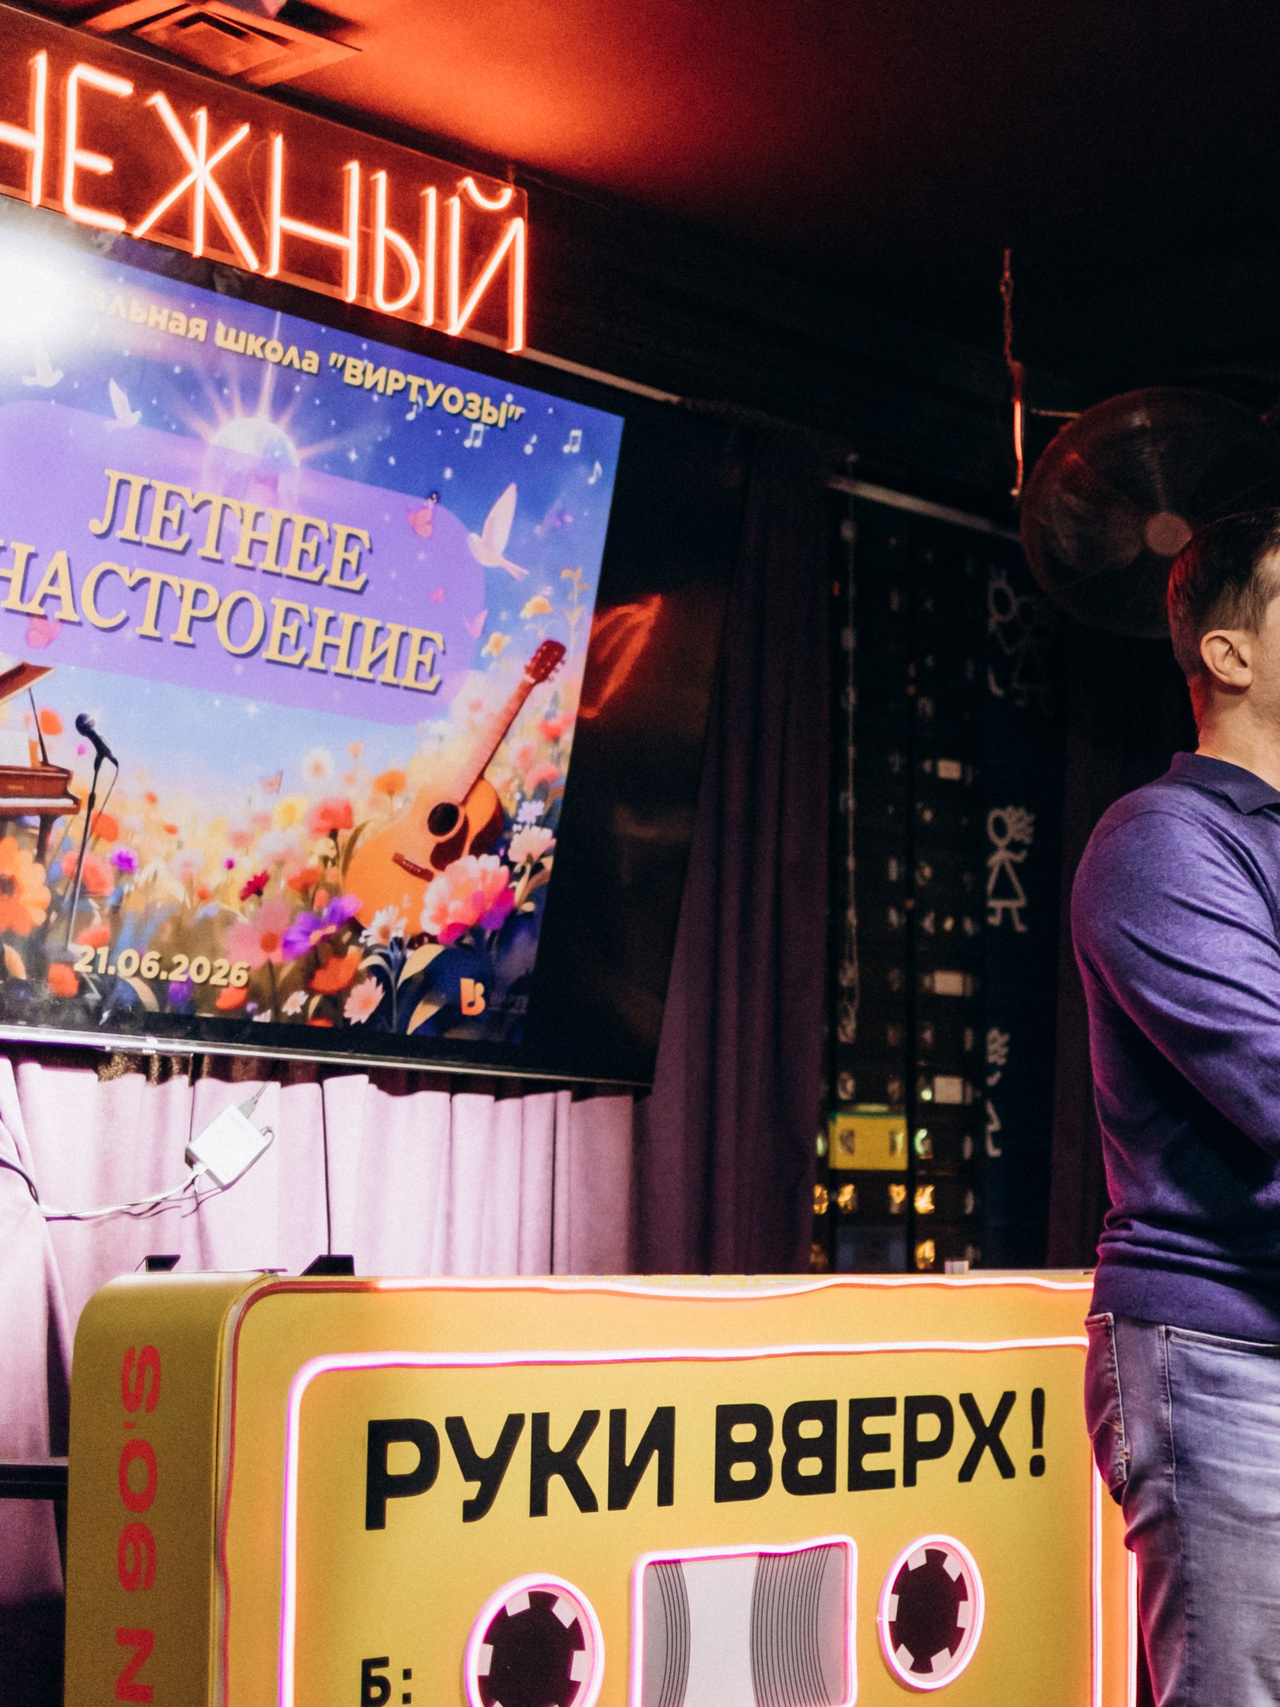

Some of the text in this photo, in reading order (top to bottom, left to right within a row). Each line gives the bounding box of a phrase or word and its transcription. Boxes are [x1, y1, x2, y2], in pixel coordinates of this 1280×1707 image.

[215, 319, 319, 375] школа
[329, 353, 525, 428] "ВИРТУОЗЫ"
[89, 469, 373, 592] ЛЕТНЕЕ
[0, 538, 447, 694] НАСТРОЕНИЕ
[74, 947, 250, 987] 21.06.2026
[116, 1344, 162, 1592] 90'S
[364, 1387, 1046, 1531] РУКИ ВВЕРХ!
[360, 1656, 413, 1706] Б:
